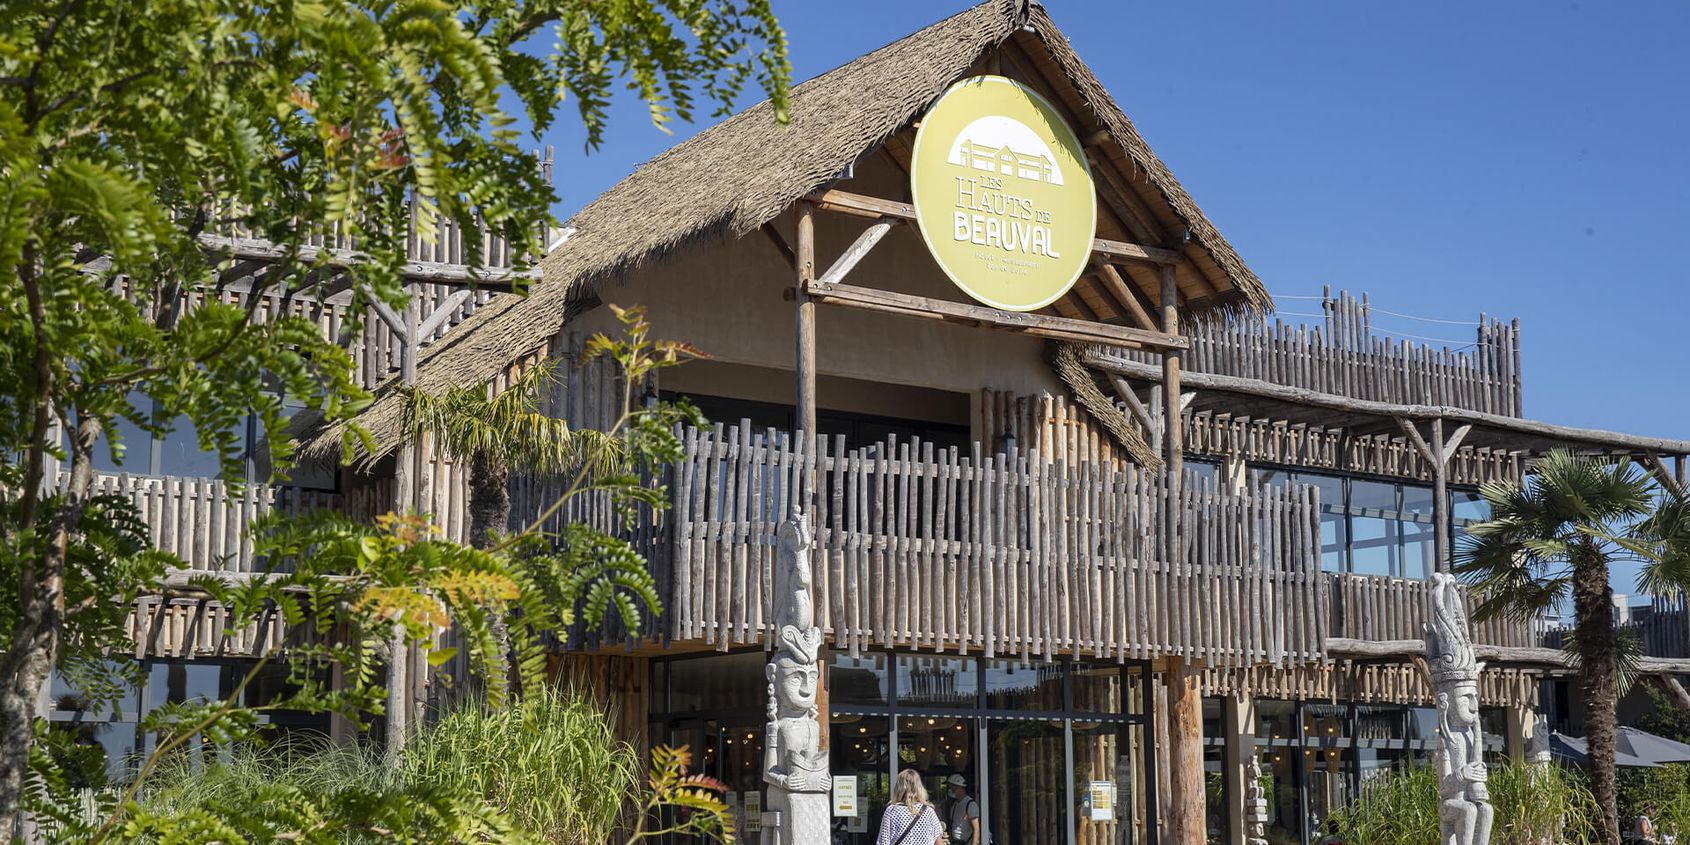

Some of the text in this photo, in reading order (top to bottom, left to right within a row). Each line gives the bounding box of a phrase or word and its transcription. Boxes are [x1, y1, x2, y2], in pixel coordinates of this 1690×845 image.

[955, 176, 1052, 224] HAUTS DE
[980, 175, 1002, 190] LES
[953, 210, 1060, 259] BEAUVAL
